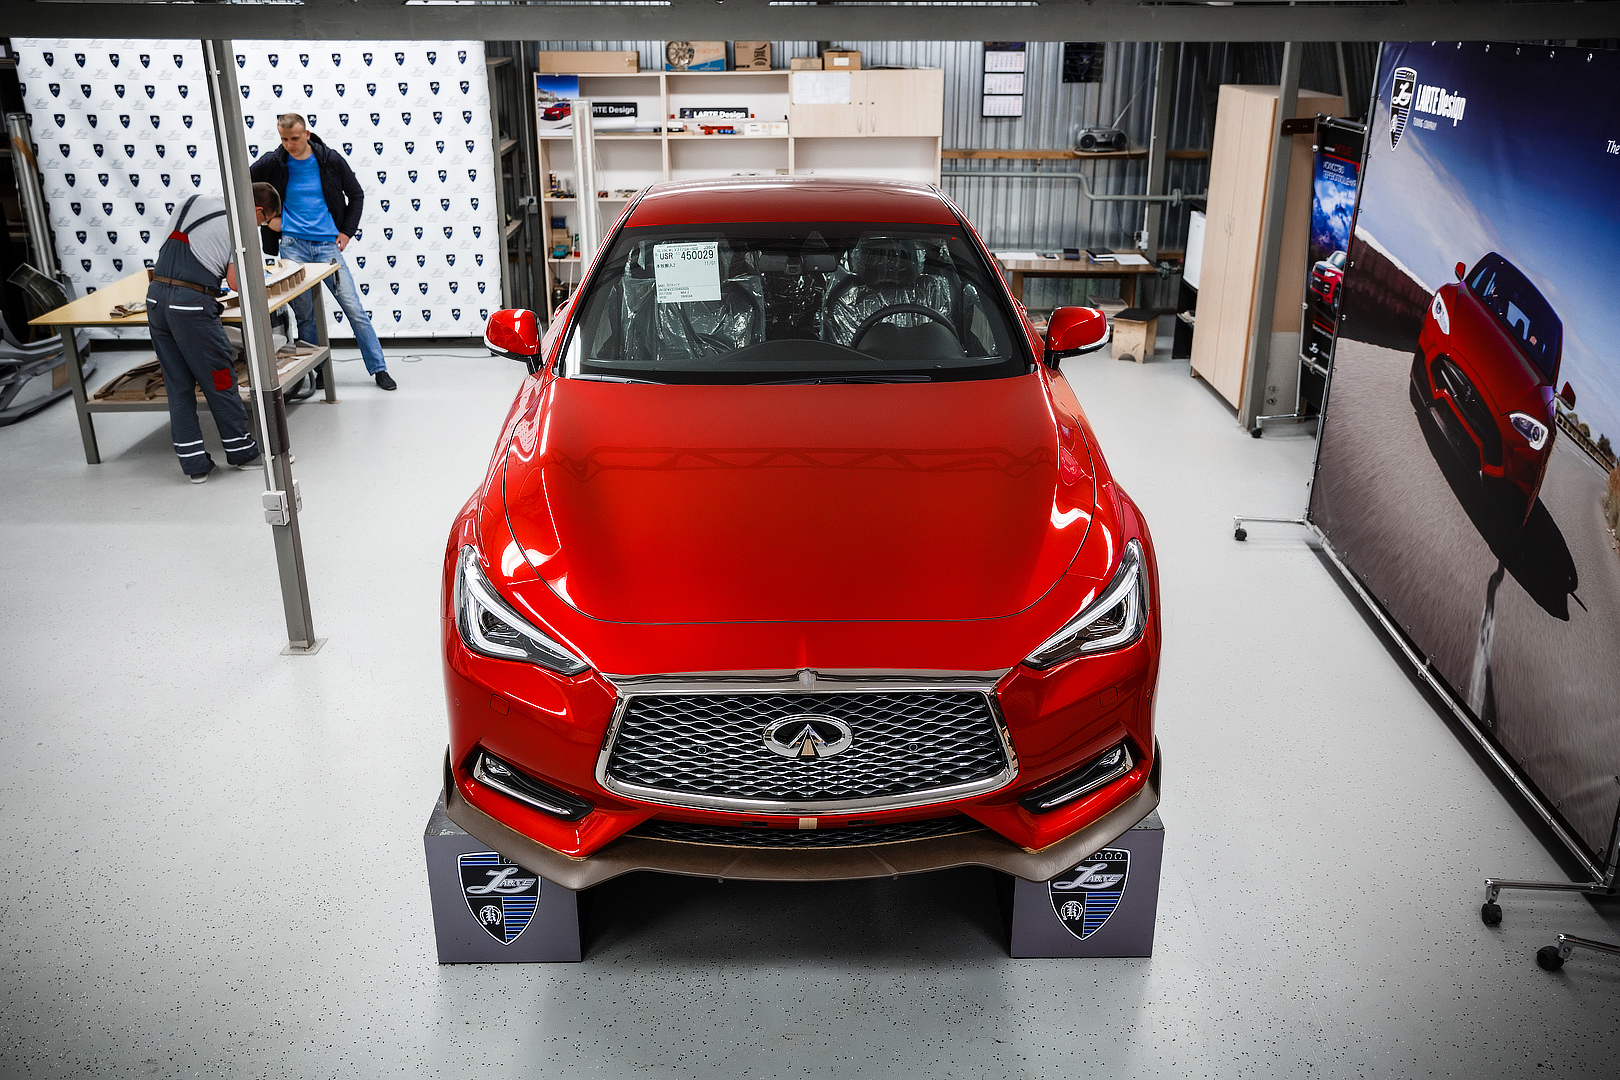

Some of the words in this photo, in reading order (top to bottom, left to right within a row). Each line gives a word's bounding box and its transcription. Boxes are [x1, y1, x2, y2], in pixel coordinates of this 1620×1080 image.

[608, 106, 635, 114] Design
[1415, 84, 1440, 114] LARTE
[1437, 88, 1466, 127] Design
[719, 111, 746, 119] Design
[1606, 139, 1620, 154] The
[659, 252, 674, 260] USR
[681, 250, 714, 260] 450029
